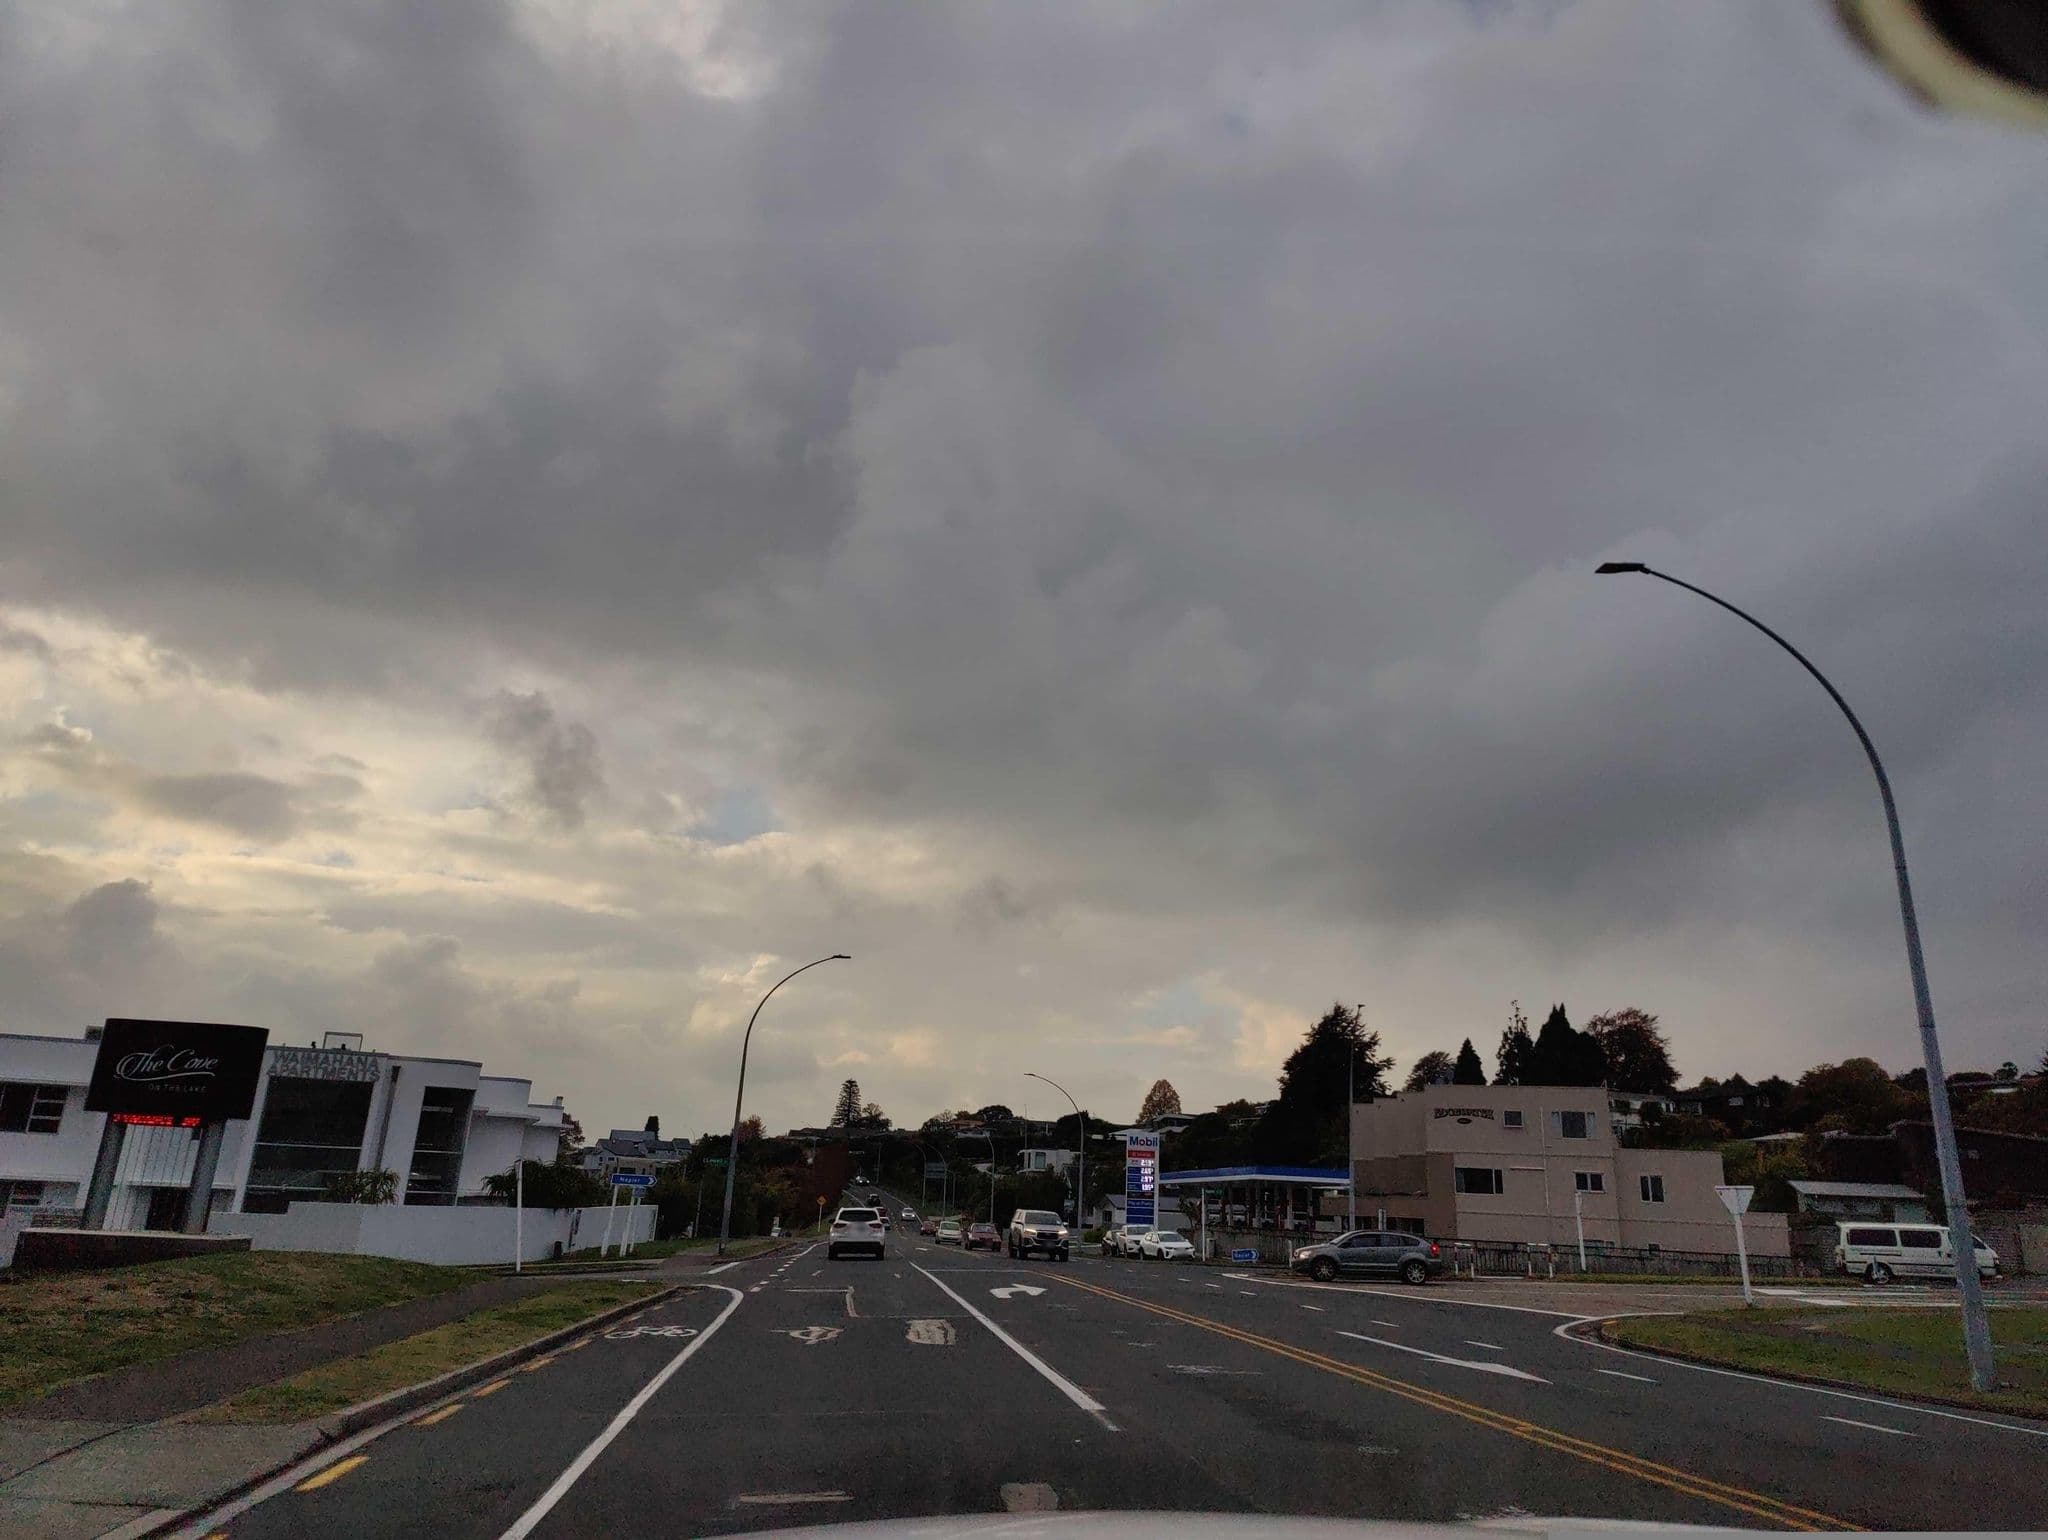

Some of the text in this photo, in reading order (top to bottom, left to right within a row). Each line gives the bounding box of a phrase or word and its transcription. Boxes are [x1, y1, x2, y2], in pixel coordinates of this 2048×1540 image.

[116, 1043, 218, 1078] The Cove
[273, 1050, 378, 1071] WAIMAHANA
[266, 1063, 380, 1082] APARTMENTS
[1129, 1136, 1158, 1147] Mobil
